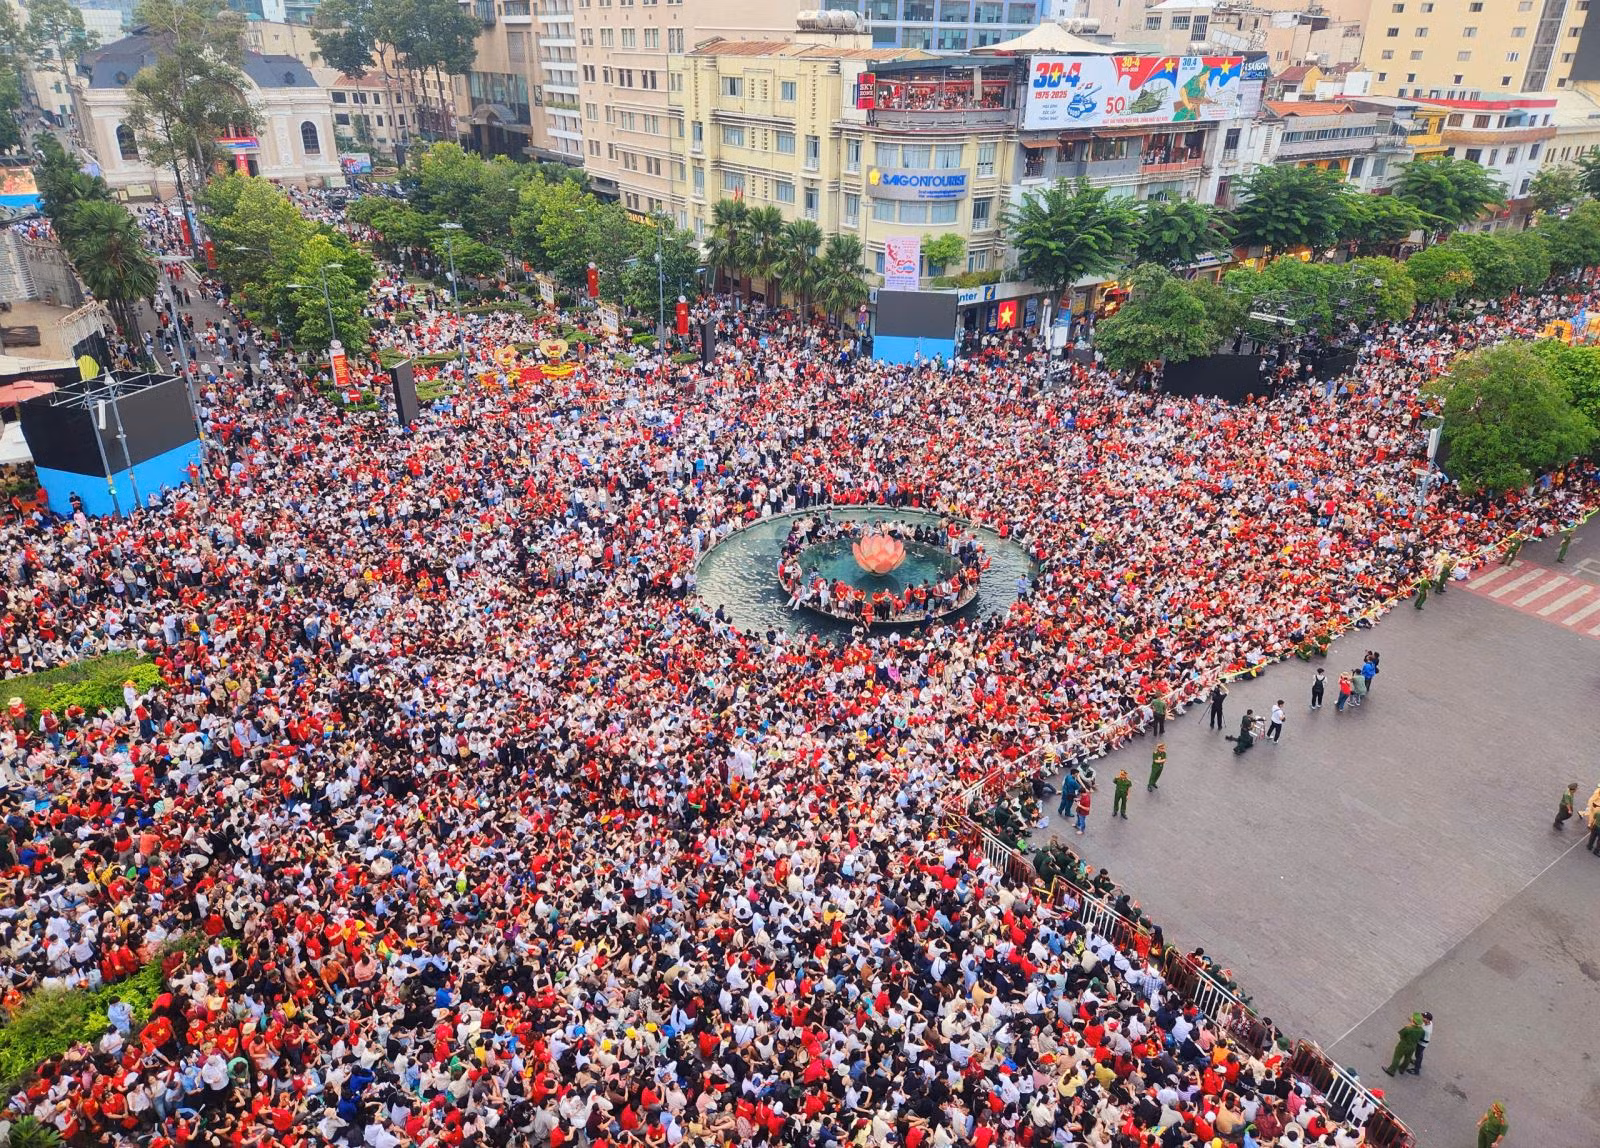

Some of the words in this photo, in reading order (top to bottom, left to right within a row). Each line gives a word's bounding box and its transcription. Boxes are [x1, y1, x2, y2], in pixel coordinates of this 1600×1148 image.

[1105, 96, 1125, 115] 50
[883, 173, 967, 187] SAIGONTOURIST
[960, 292, 978, 302] nter
